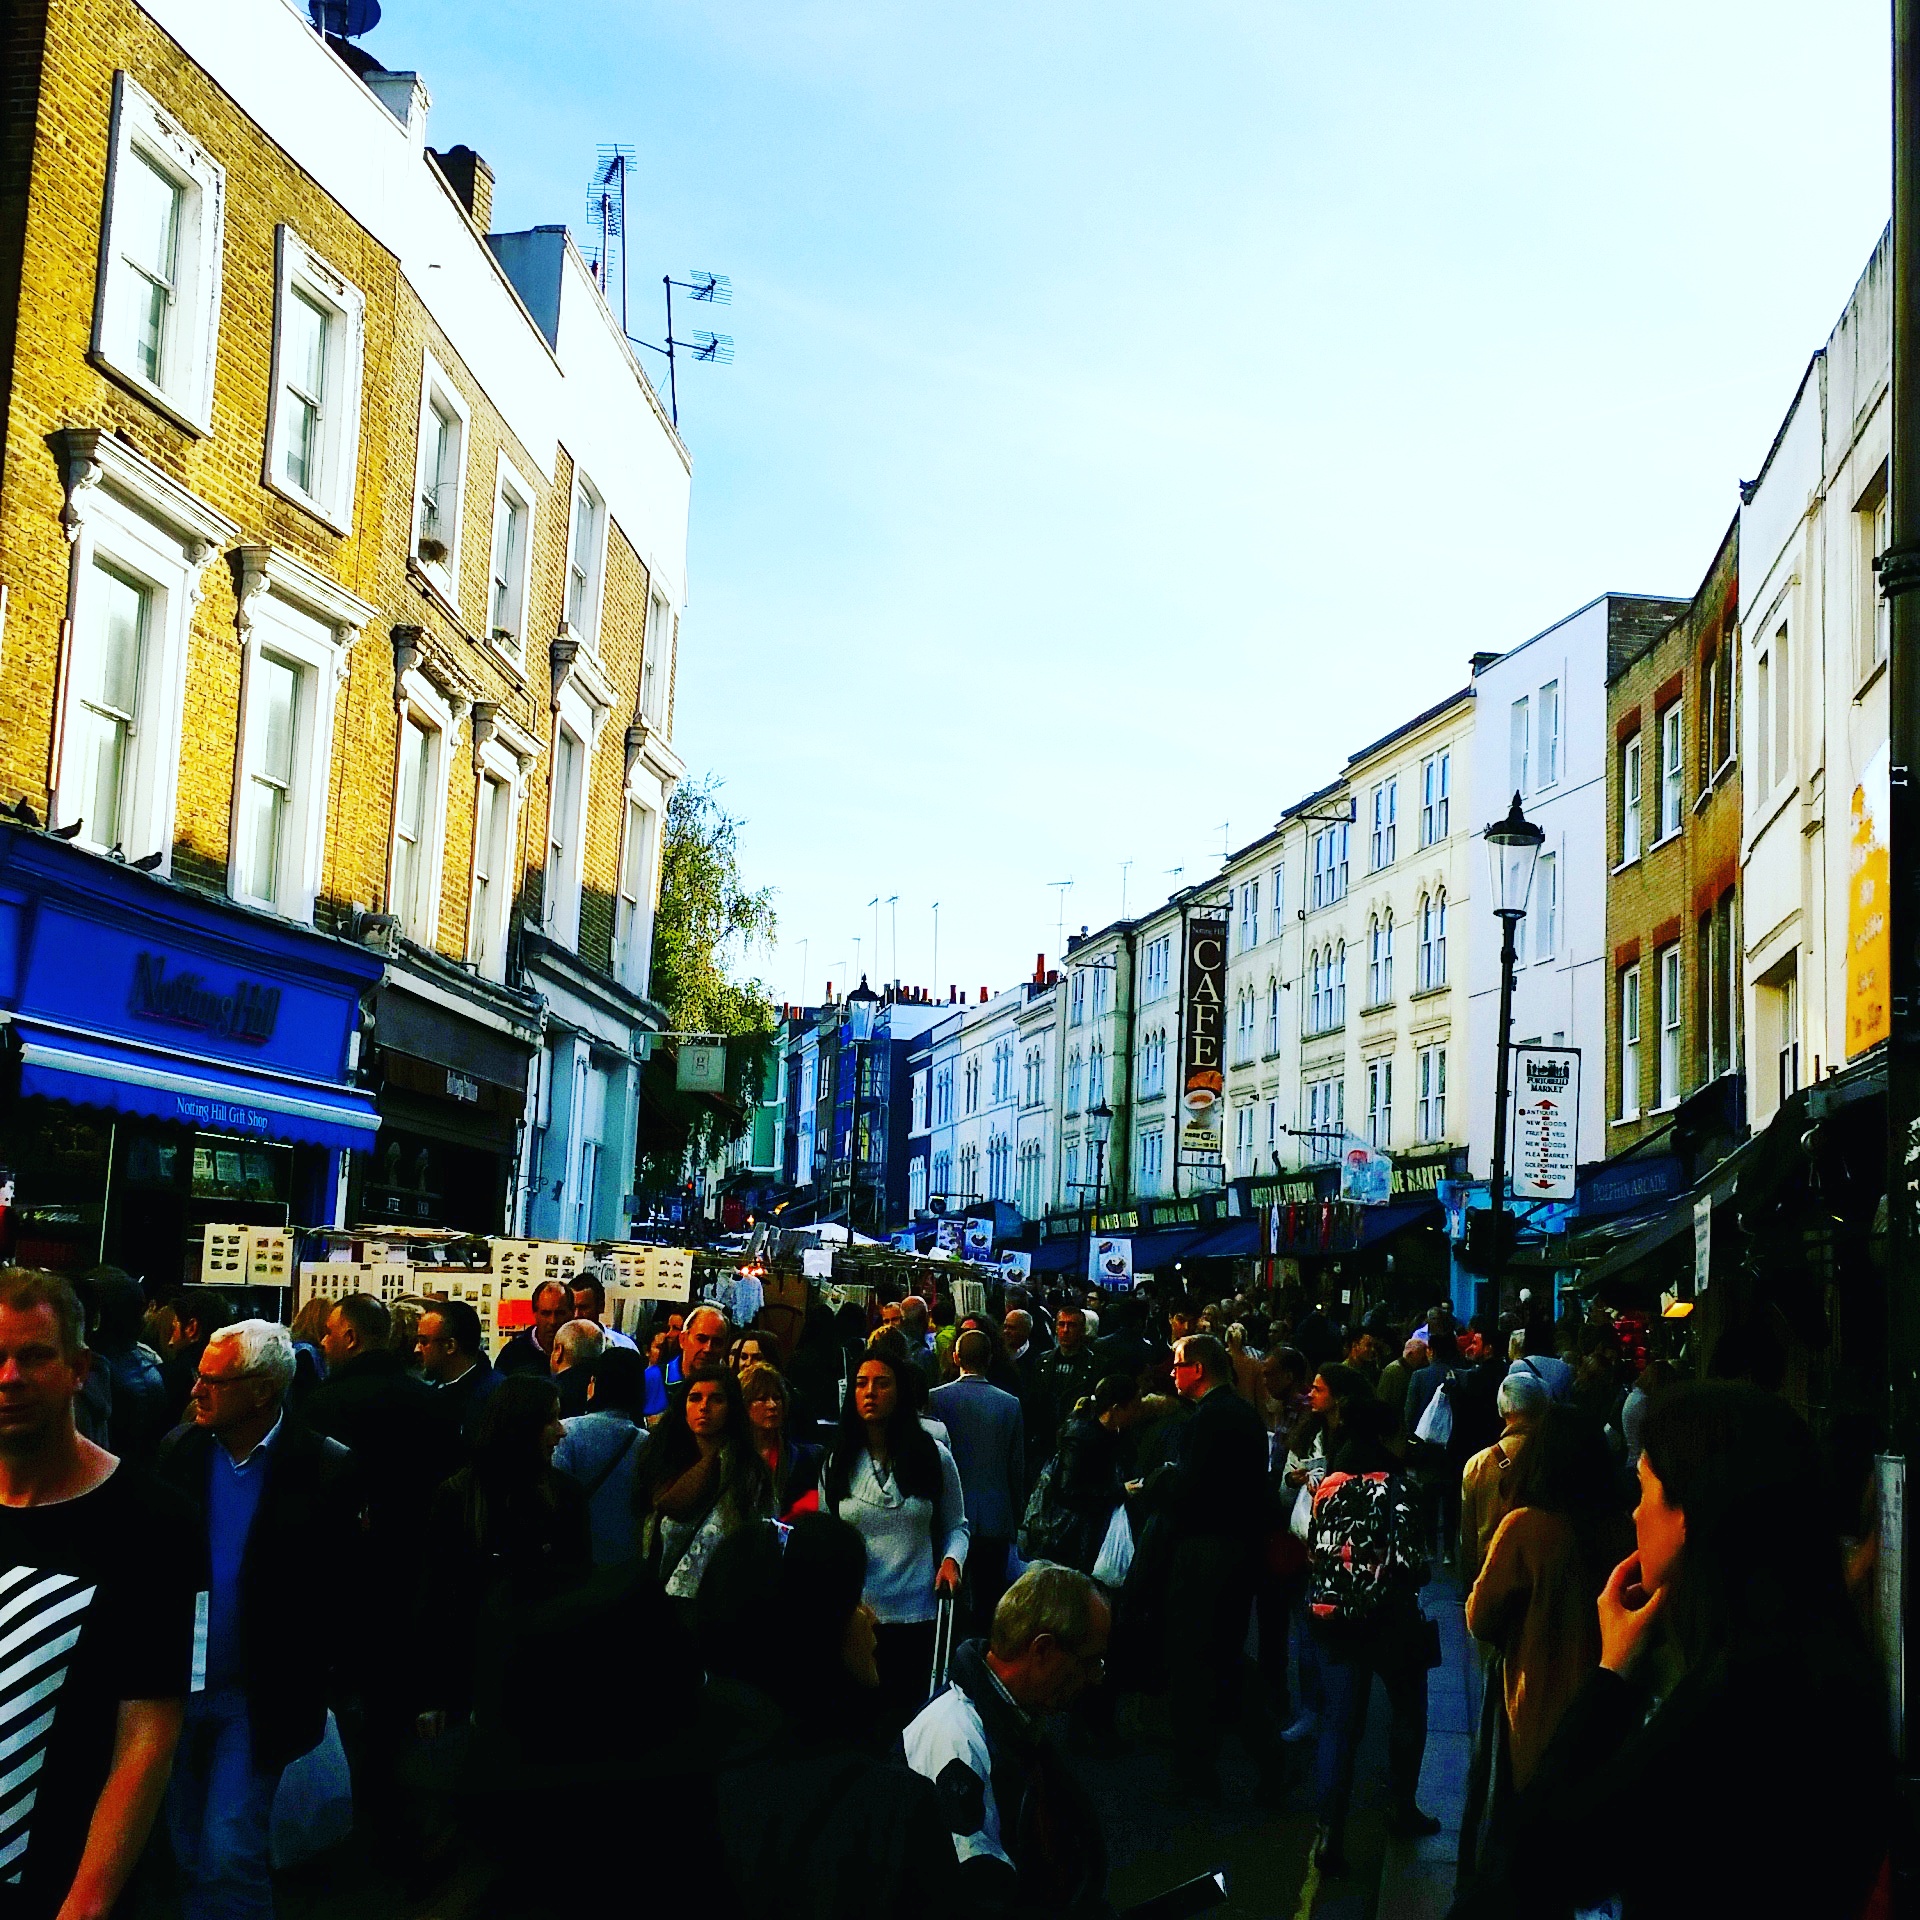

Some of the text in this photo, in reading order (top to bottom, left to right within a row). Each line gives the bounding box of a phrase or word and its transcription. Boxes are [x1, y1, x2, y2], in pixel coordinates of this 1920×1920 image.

[231, 980, 281, 1036] Hill
[1189, 939, 1222, 1067] CAFE
[1530, 1083, 1564, 1093] MARKET
[176, 1097, 268, 1132] Notting Hill Gift Shop
[1542, 1141, 1567, 1149] GOODS
[1406, 1164, 1446, 1191] MARKET
[1541, 1173, 1566, 1181] GOODS
